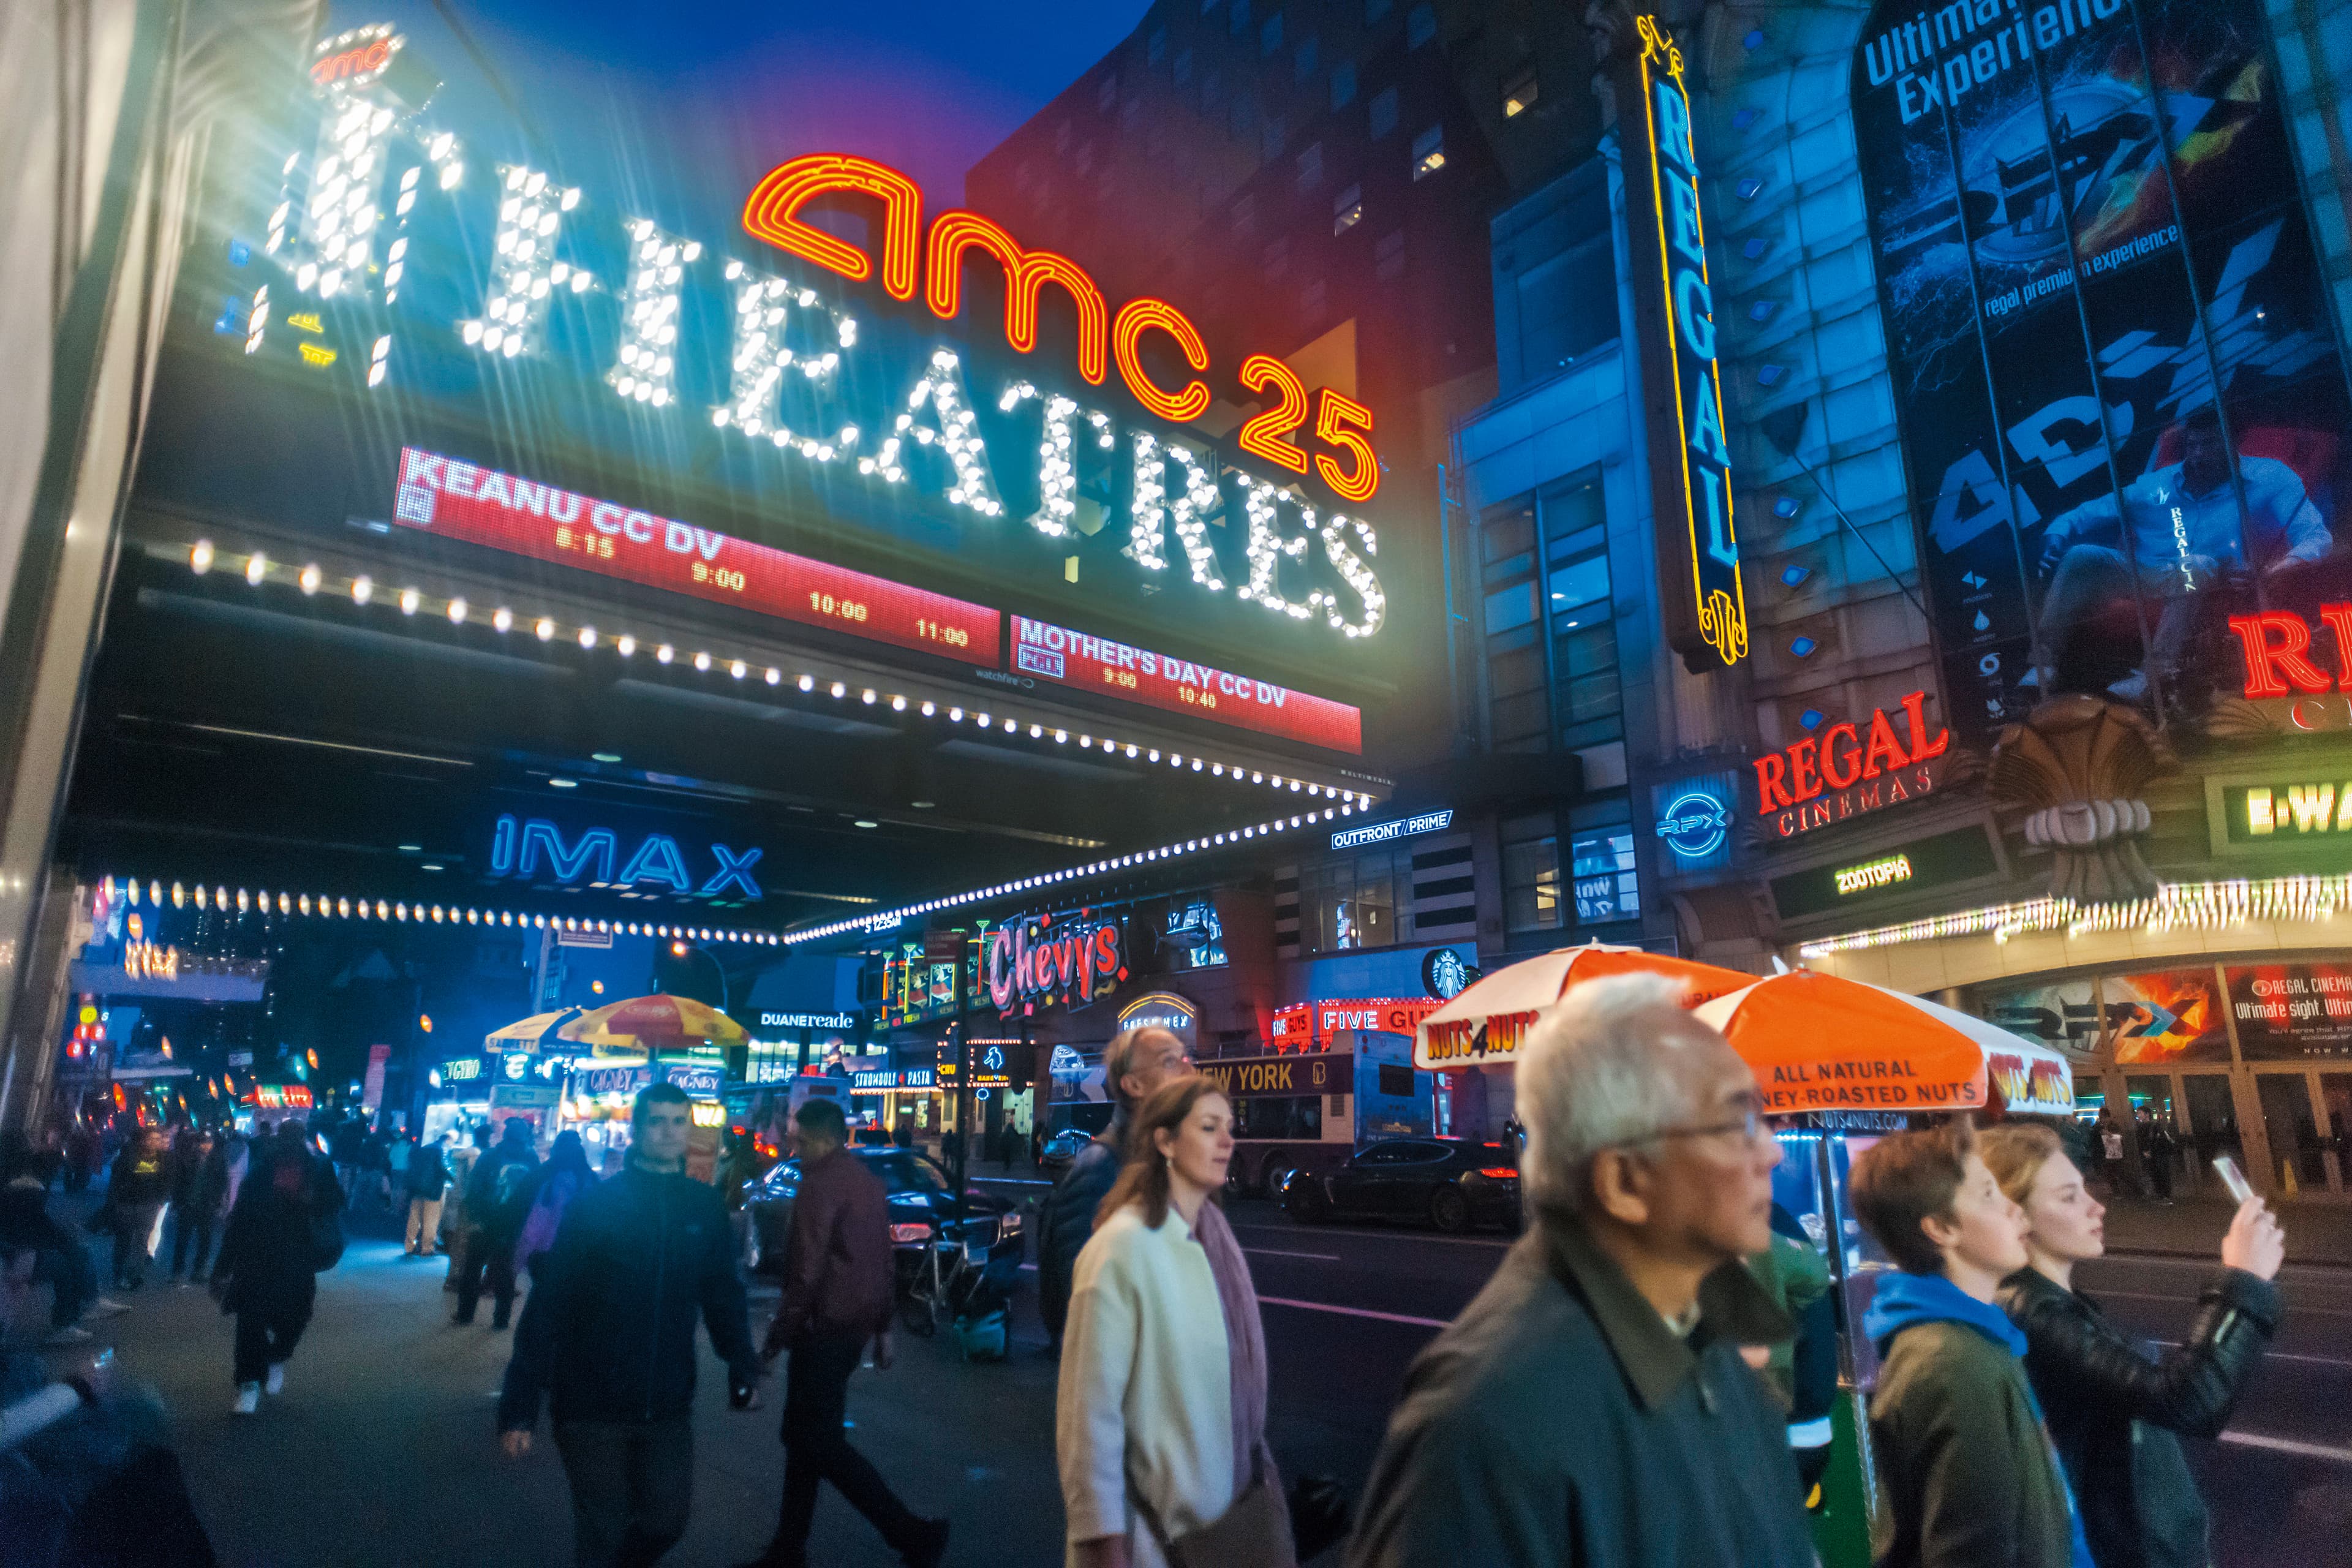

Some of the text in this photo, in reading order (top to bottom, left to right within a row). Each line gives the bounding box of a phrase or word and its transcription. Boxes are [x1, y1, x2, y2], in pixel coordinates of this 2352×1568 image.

[1985, 287, 2021, 317] regal
[2092, 225, 2179, 274] experience
[742, 152, 1381, 502] amc 25
[1656, 79, 1738, 568] REGAL
[288, 95, 1389, 638] THEATRES
[405, 449, 724, 560] KEANU CC DV
[2170, 507, 2190, 557] REGAL
[692, 560, 745, 592] 9:00
[810, 592, 867, 621] 10:00
[916, 619, 968, 647] 11:00
[976, 669, 1019, 685] watchfire
[1020, 616, 1286, 708] MOTHER'S DAY CC DV
[1103, 666, 1216, 709] 9:00 10:40
[1752, 690, 1949, 815] REGAL
[1778, 767, 1932, 837] CINEMAS
[1334, 813, 1447, 847] OUTFRONT PRIME
[1656, 810, 1726, 837] RPX
[492, 813, 764, 901] IMAX
[1835, 855, 1912, 894] ZOOTOPIA
[990, 923, 1120, 1011] Chevys
[2272, 978, 2309, 997] REGAL
[1163, 1016, 1188, 1028] MEX
[1272, 1014, 1306, 1037] FIVE GUYS
[1324, 1011, 1378, 1030] FIVE
[2236, 1001, 2286, 1019] Ultimate
[2289, 999, 2323, 1020] sight.
[1427, 1018, 1473, 1060] NUTS
[666, 1074, 720, 1090] CAGNEY
[855, 1071, 930, 1087] STROMBOLI PASTA
[1238, 1063, 1292, 1090] YORK
[1774, 1060, 1917, 1083] ALL NATURAL
[1917, 1082, 1976, 1102] NUTS
